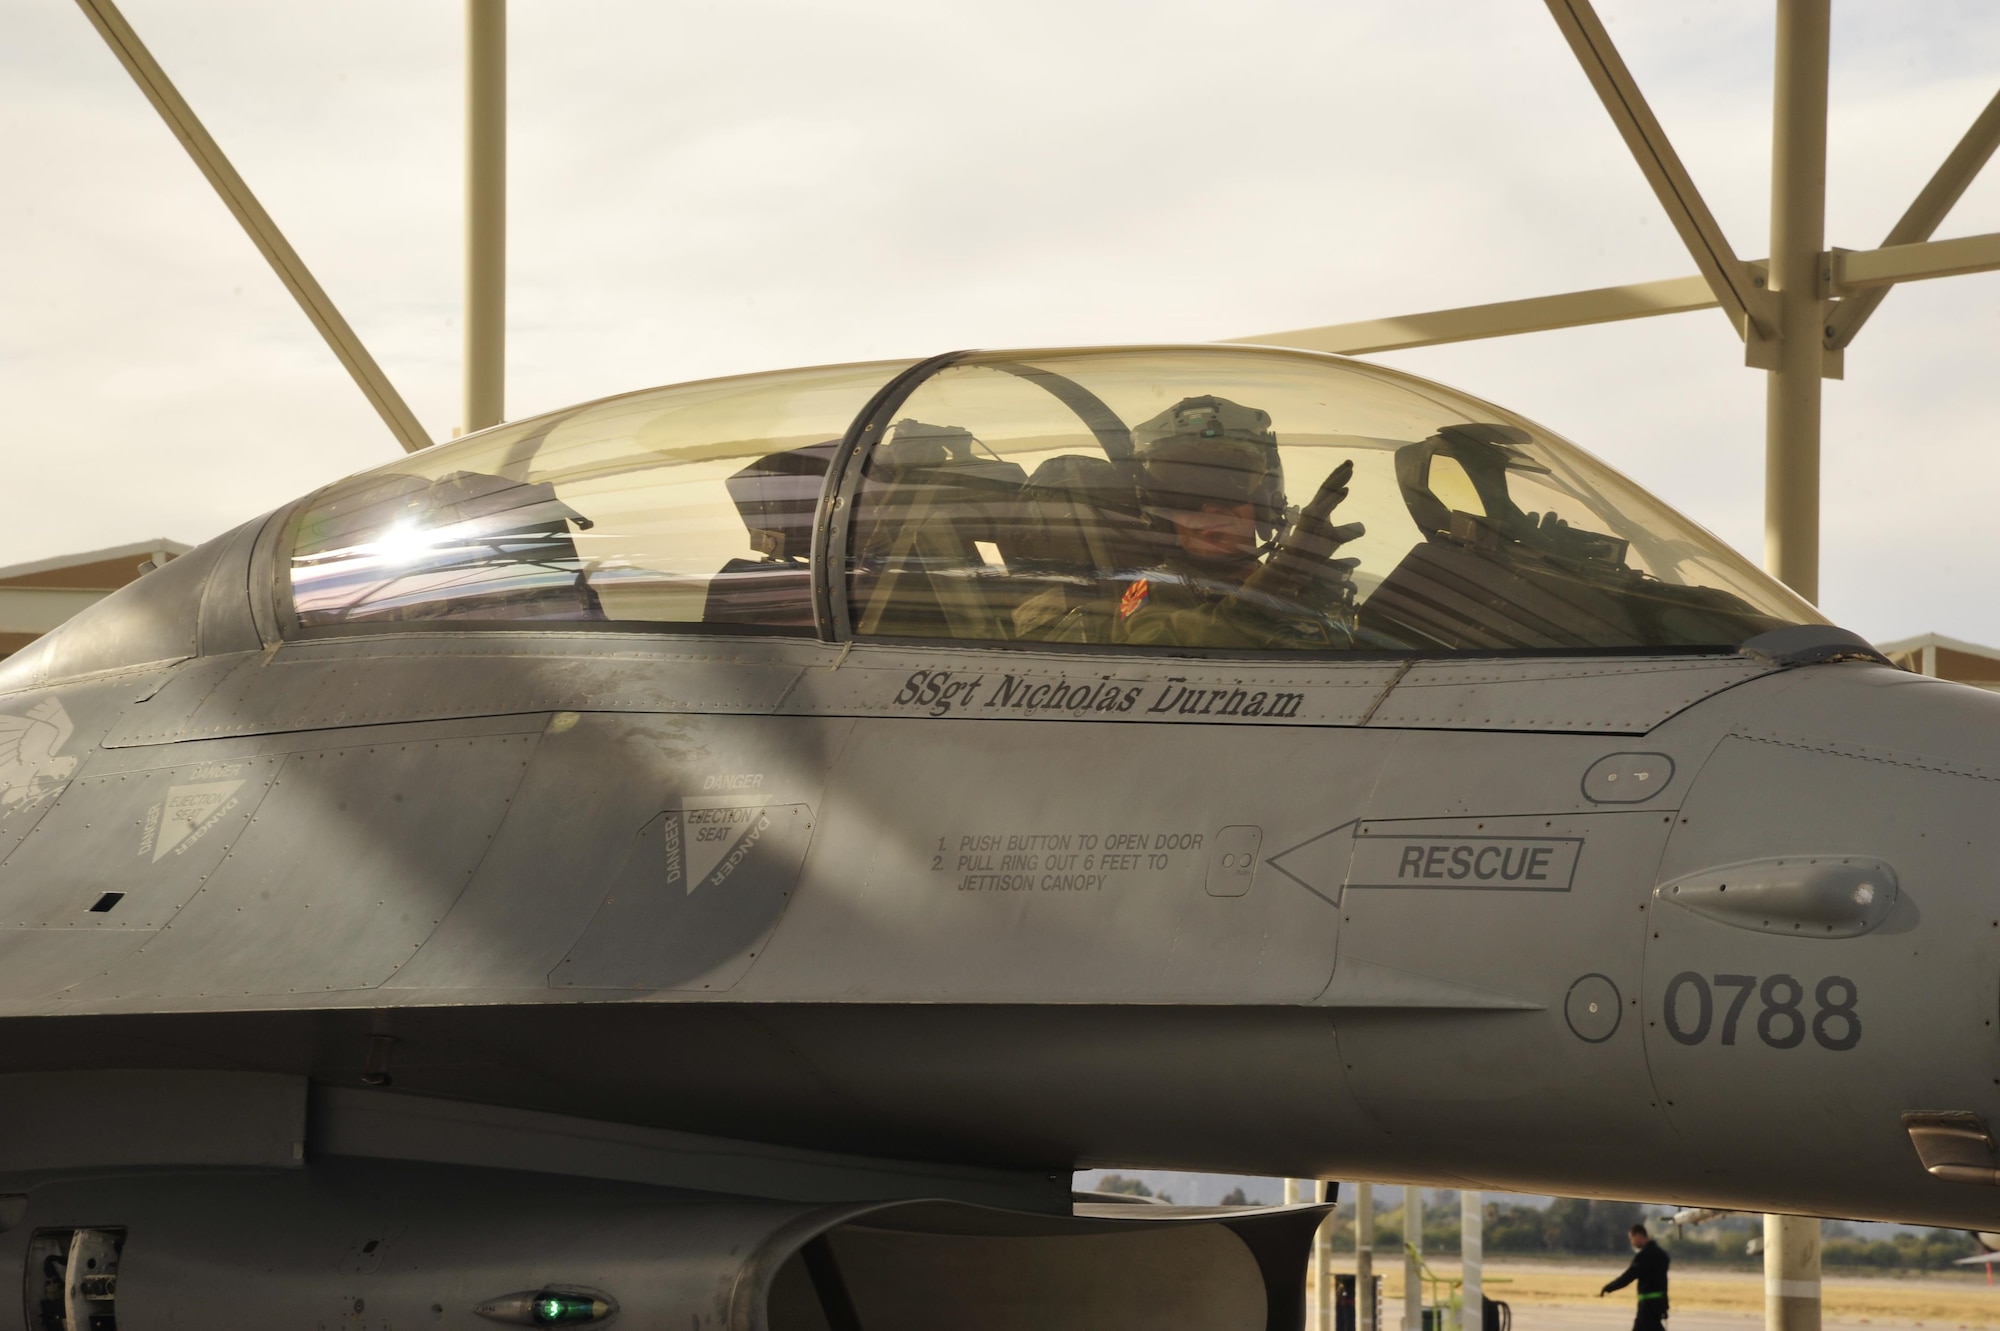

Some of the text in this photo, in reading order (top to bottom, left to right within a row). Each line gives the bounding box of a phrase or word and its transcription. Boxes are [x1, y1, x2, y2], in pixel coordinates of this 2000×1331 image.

[893, 670, 1304, 718] SSgt Nicholas Durham
[190, 764, 242, 780] DANGER
[703, 774, 763, 790] DANGER
[138, 803, 161, 855] DANGER
[174, 797, 239, 855] DANGER
[687, 808, 753, 824] EJECTION
[696, 827, 732, 842] SEAT
[938, 834, 1204, 851] 1. PUSH BUTTON TO OPEN DOOR
[664, 816, 681, 884] DANGER
[711, 816, 771, 886] DANGER
[931, 853, 1168, 871] 2. PULL RING OUT 6 FEET TO
[1398, 845, 1554, 881] RESCUE
[958, 874, 1107, 891] JETTISON CANOPY
[1663, 970, 1862, 1051] 0788
